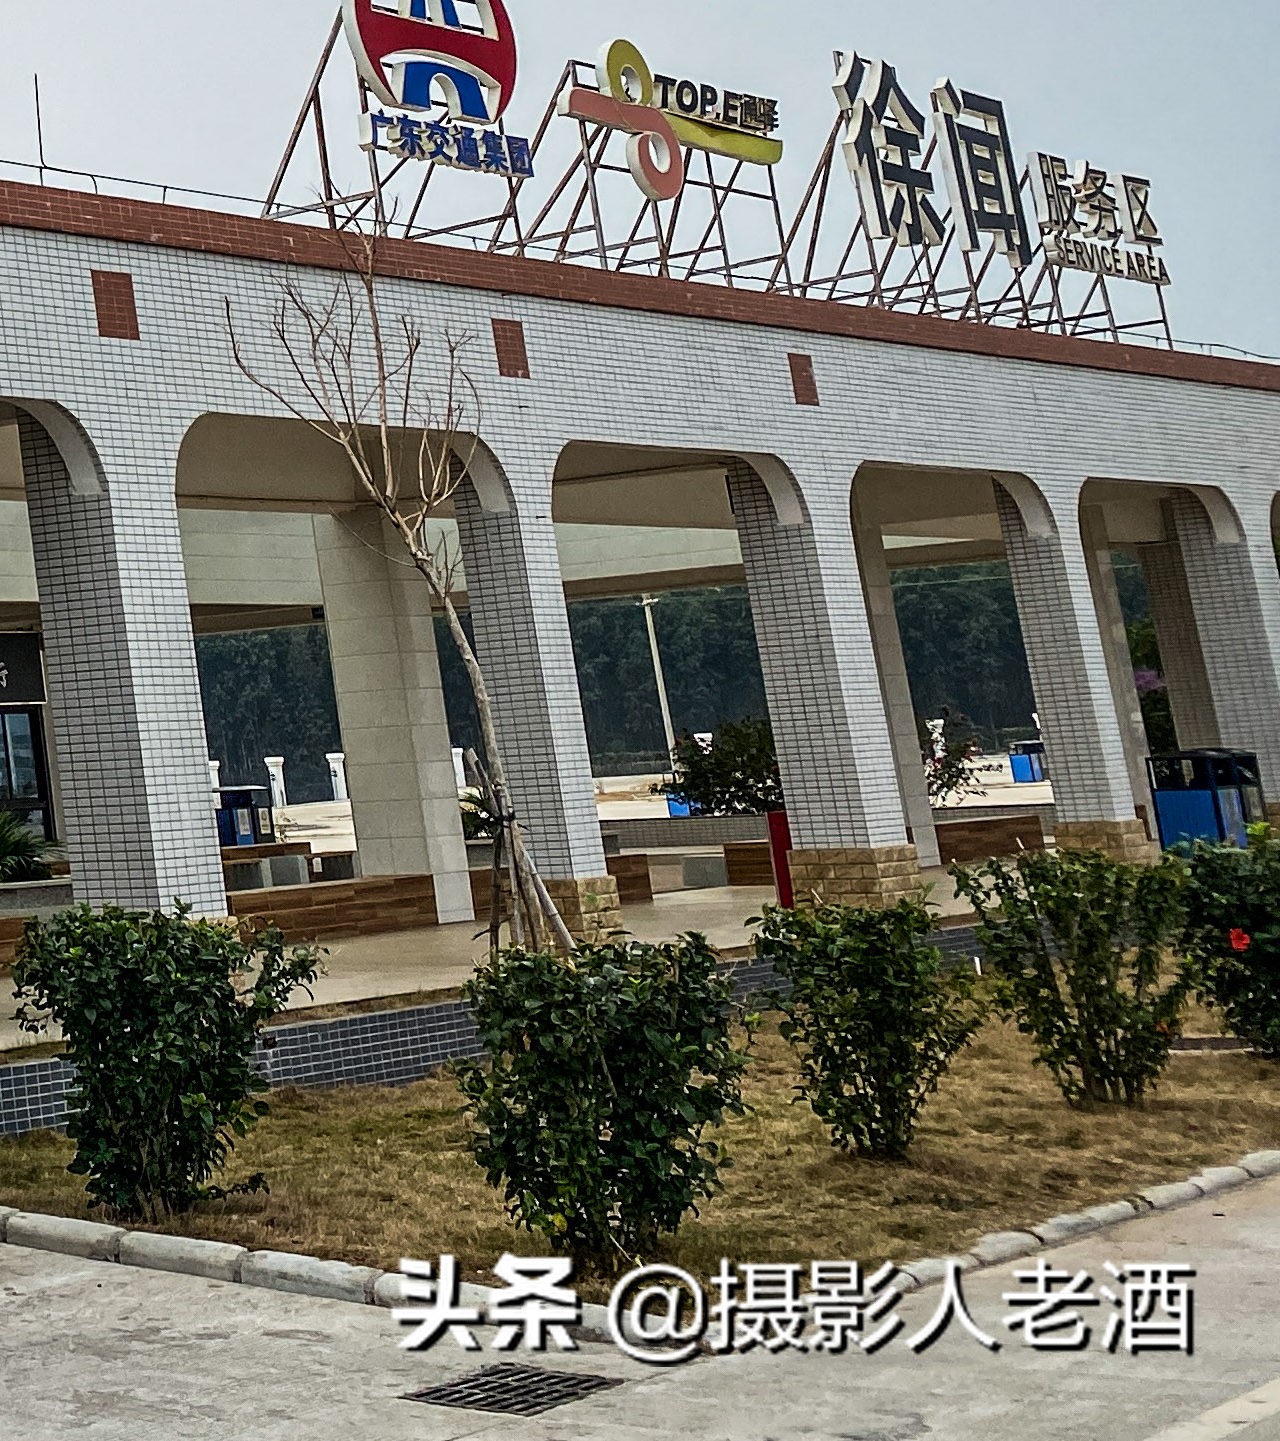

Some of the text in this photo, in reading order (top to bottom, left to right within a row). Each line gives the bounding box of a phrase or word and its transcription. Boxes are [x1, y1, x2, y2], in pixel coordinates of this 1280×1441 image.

[359, 110, 535, 178] 广东交通集团
[833, 50, 1034, 269] 徐闻
[1027, 152, 1165, 247] 服务区
[1047, 233, 1171, 285] SERVICE AREA
